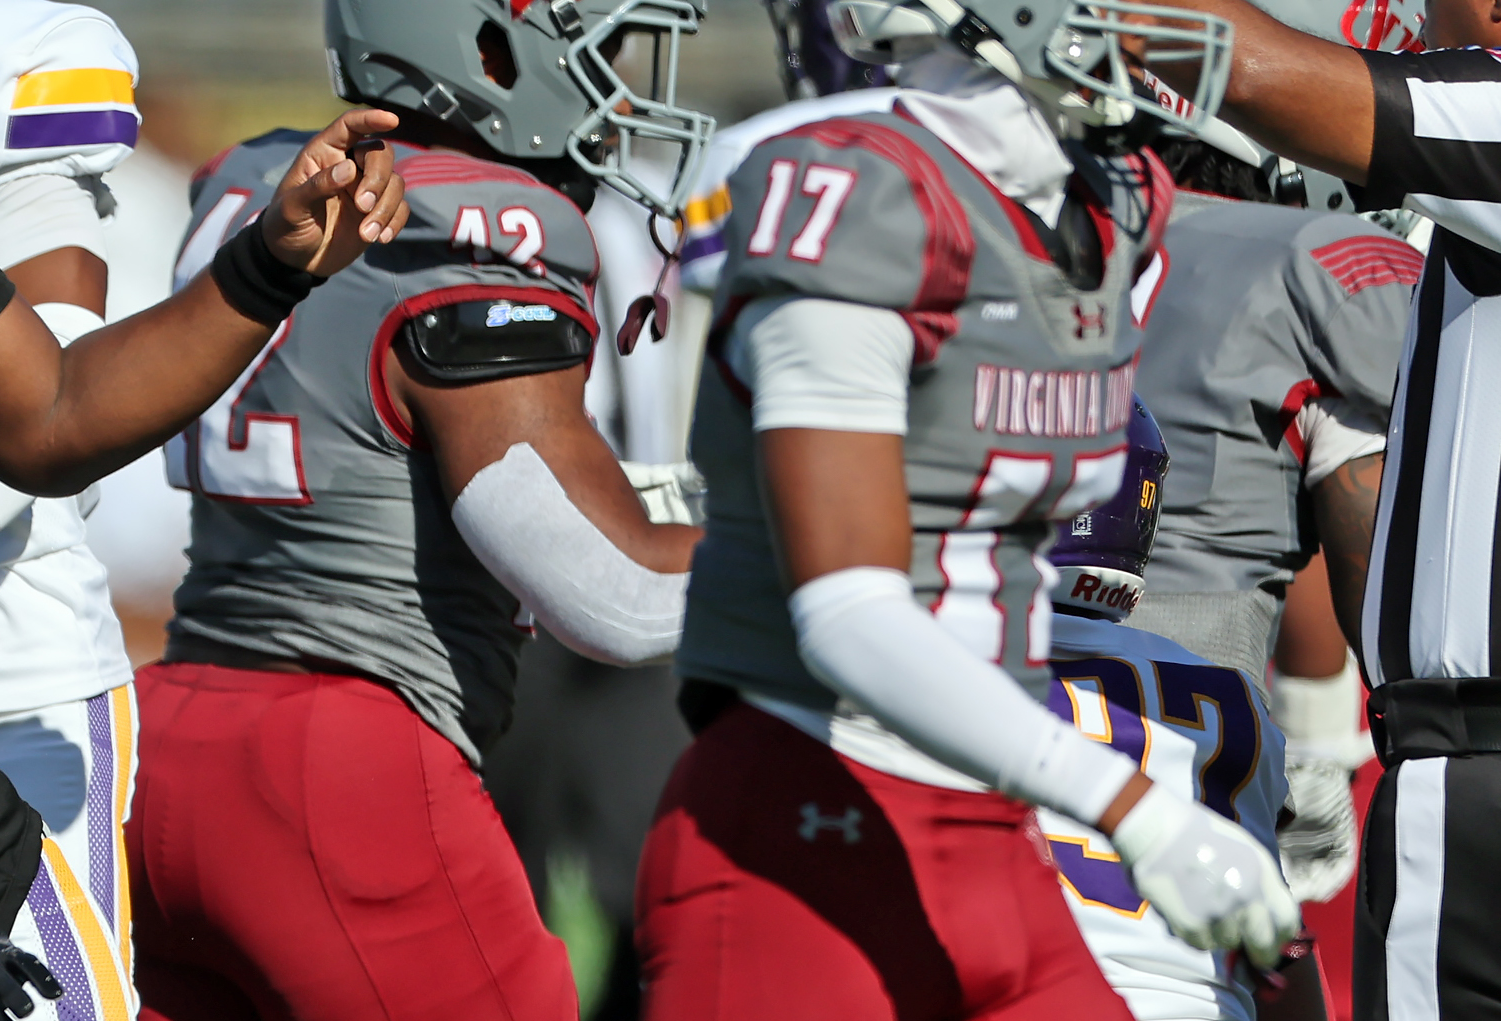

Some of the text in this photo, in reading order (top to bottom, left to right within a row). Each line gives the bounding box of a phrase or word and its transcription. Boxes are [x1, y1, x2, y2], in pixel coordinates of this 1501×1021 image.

[451, 204, 546, 278] 42
[747, 158, 858, 266] 17
[973, 363, 1101, 438] VIRGINIA
[1139, 479, 1157, 510] 97
